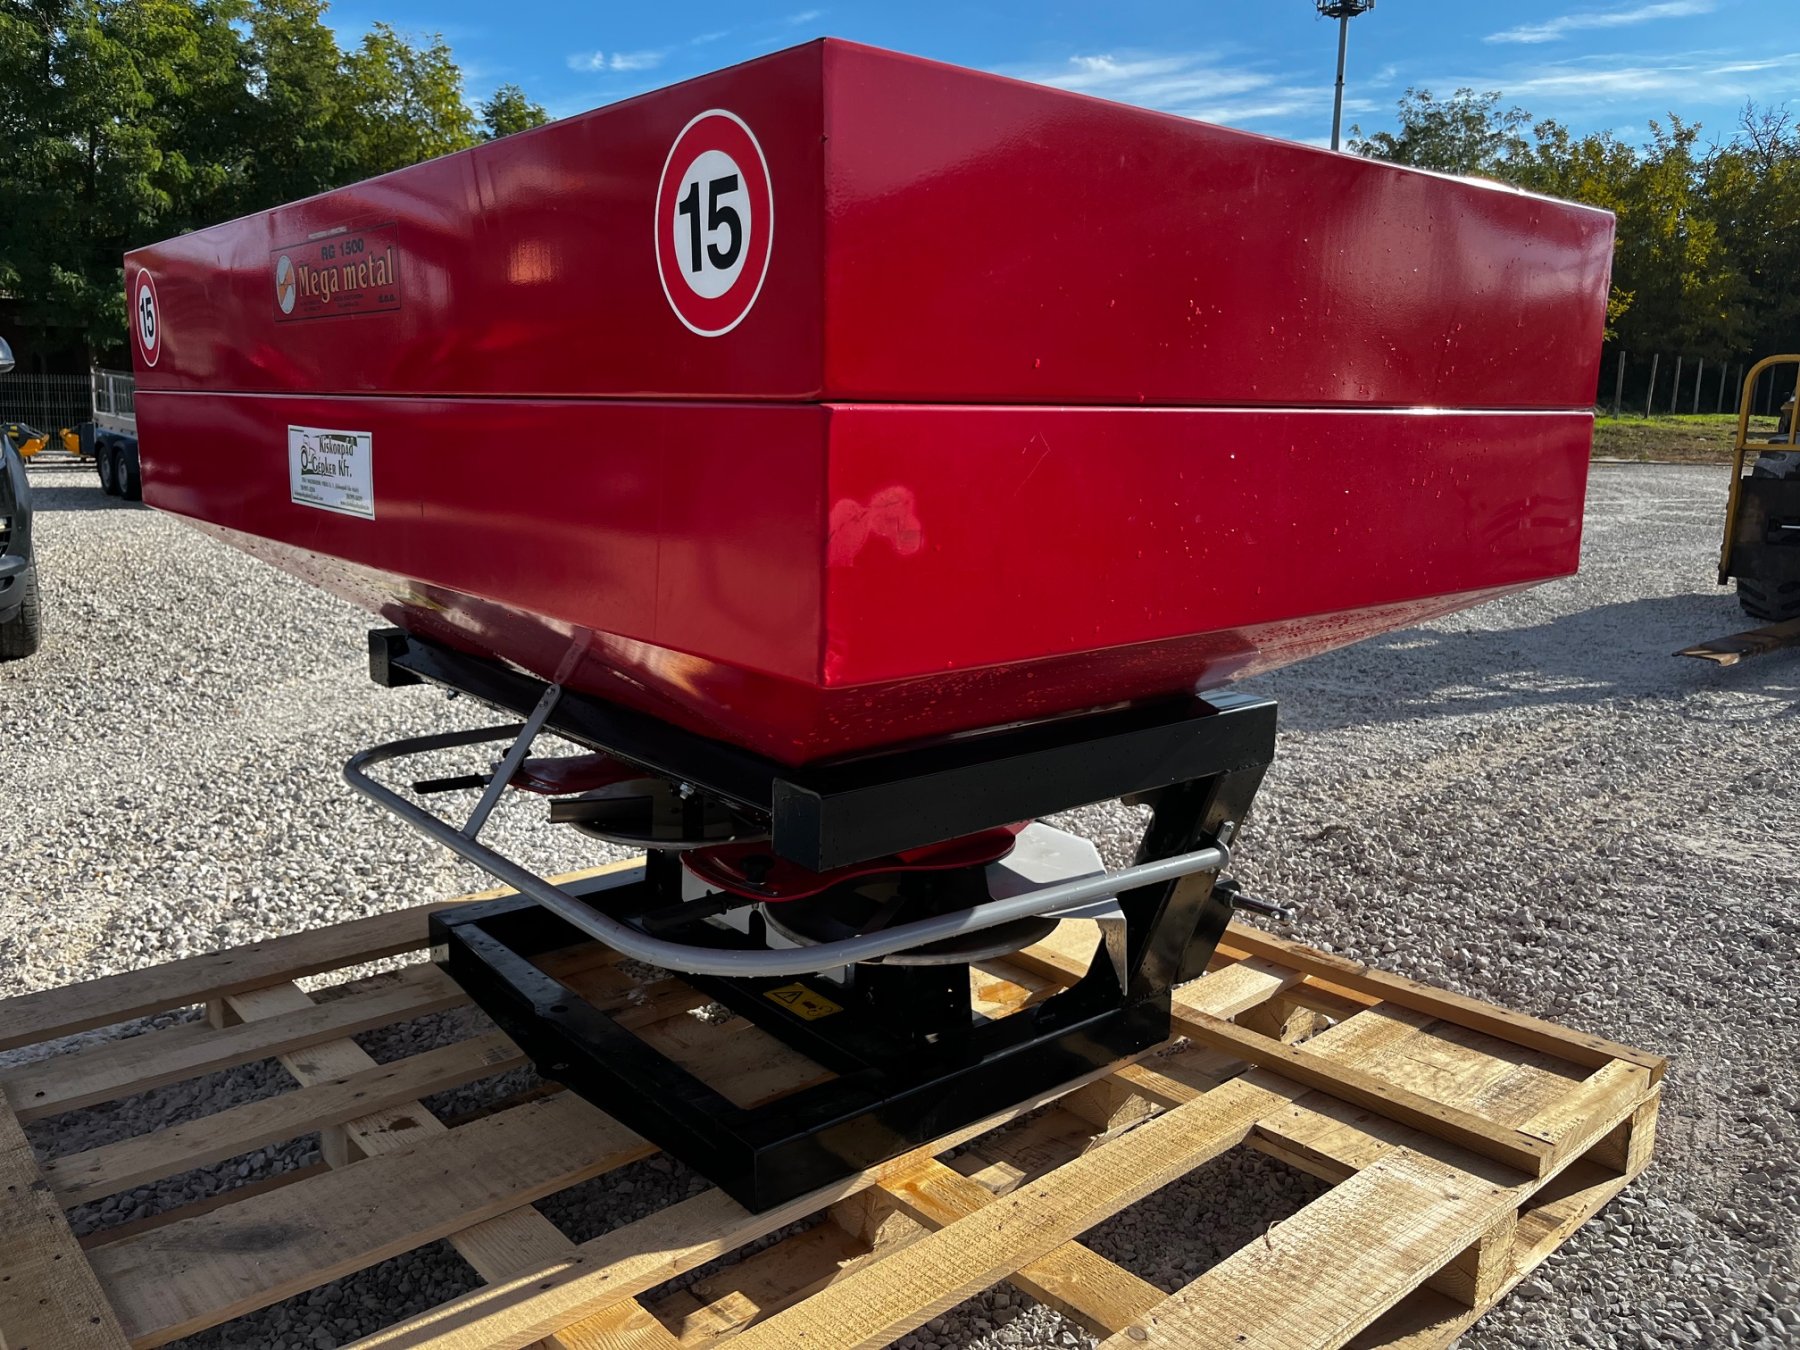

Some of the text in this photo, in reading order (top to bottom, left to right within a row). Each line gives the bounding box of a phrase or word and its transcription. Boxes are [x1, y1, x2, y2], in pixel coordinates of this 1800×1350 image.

[679, 173, 741, 273] 15
[321, 238, 364, 260] RG 1500
[298, 245, 394, 303] Mega metal
[140, 297, 155, 338] 15
